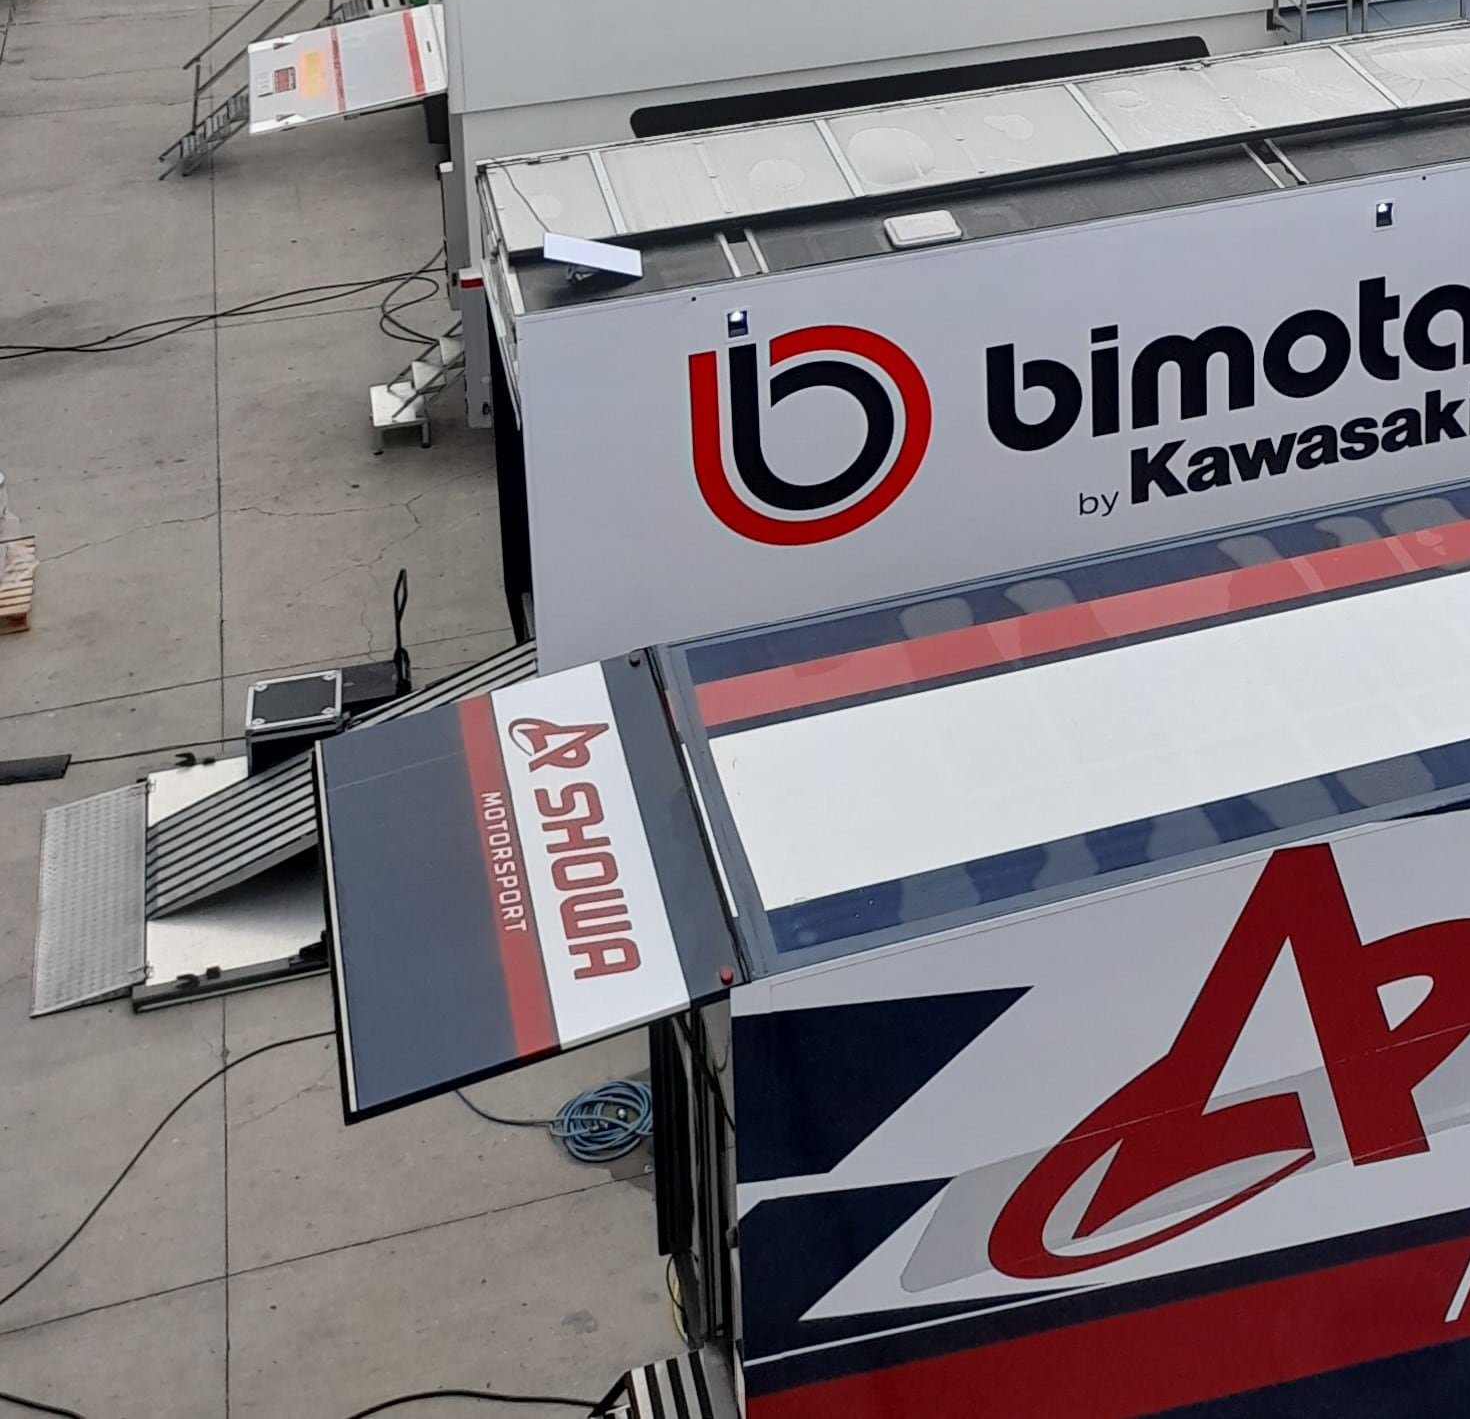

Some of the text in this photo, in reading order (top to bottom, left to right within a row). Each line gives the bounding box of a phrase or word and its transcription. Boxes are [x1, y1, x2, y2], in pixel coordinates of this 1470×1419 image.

[1078, 489, 1120, 518] by
[480, 791, 528, 933] MOTORSPORT
[533, 781, 642, 980] SHOWA
